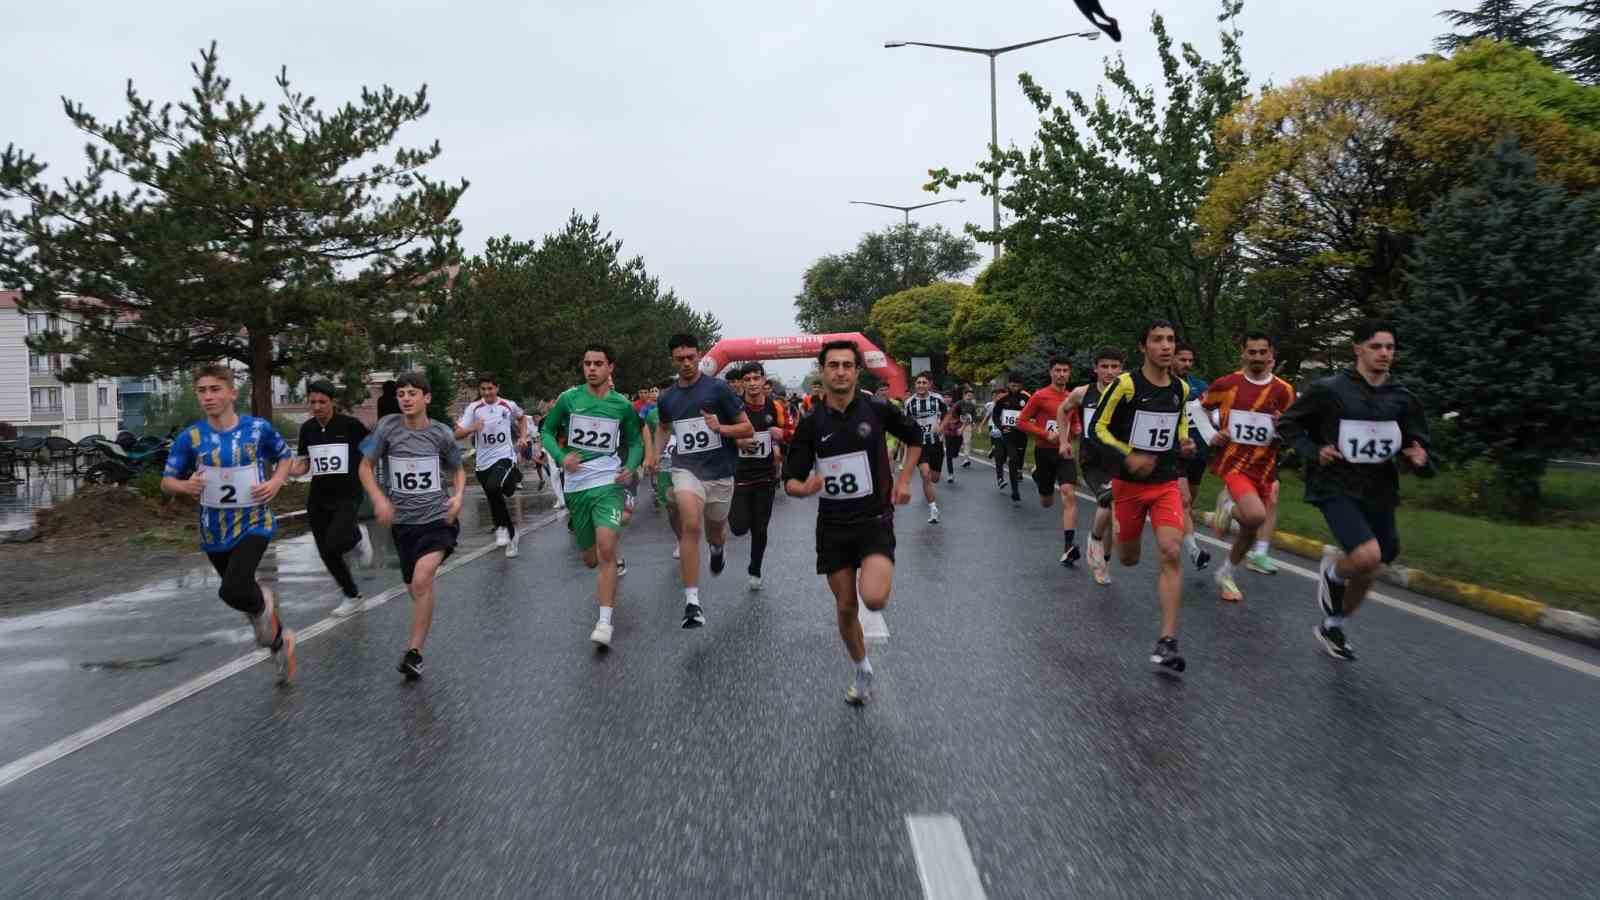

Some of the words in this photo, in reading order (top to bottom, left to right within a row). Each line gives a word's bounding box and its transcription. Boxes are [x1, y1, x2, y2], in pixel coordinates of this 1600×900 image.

[482, 432, 506, 444] 160
[572, 429, 611, 448] 222
[683, 431, 710, 450] 99
[1149, 428, 1170, 447] 15
[1234, 424, 1268, 442] 138
[1348, 438, 1392, 458] 143
[314, 456, 342, 472] 159
[395, 472, 432, 490] 163
[824, 473, 859, 496] 68
[220, 484, 237, 503] 2
